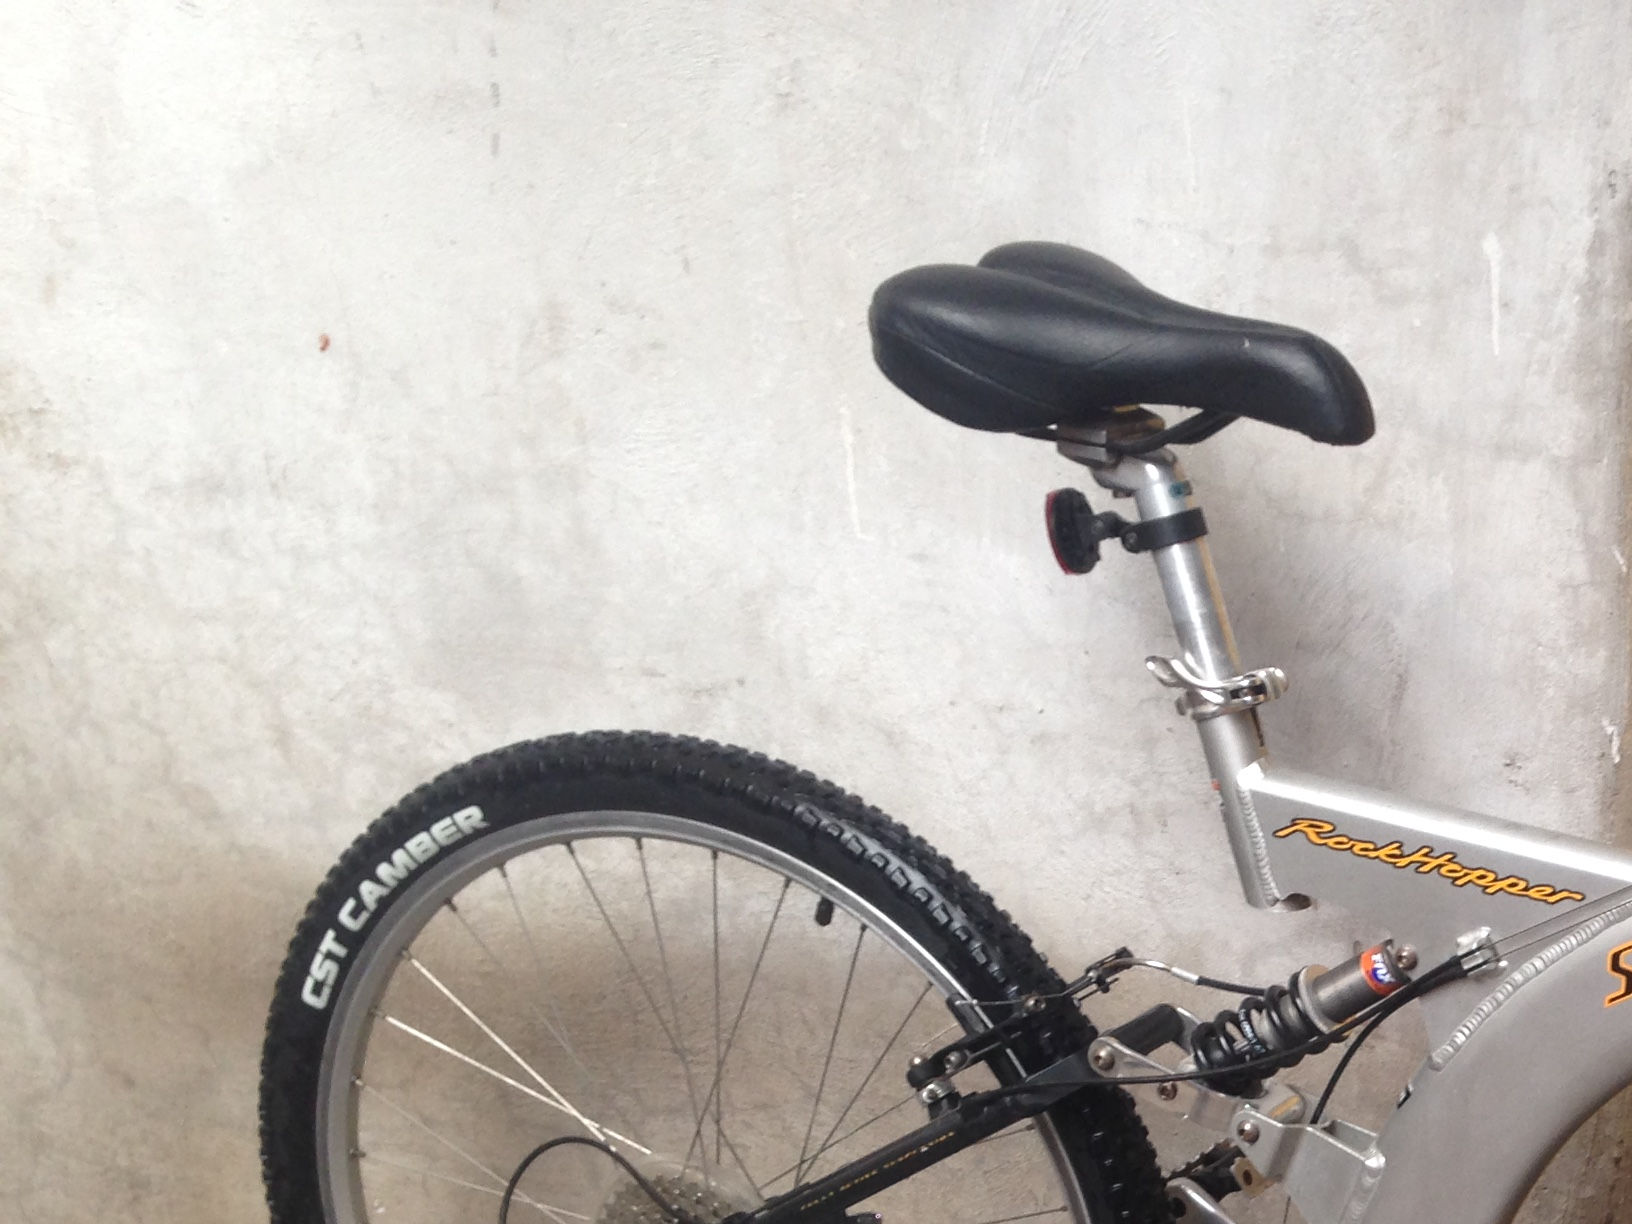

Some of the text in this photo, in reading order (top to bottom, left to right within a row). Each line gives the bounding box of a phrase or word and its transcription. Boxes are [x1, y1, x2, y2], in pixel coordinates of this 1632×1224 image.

[301, 805, 490, 1010] CST CAMBER
[1273, 818, 1586, 905] RockHopper
